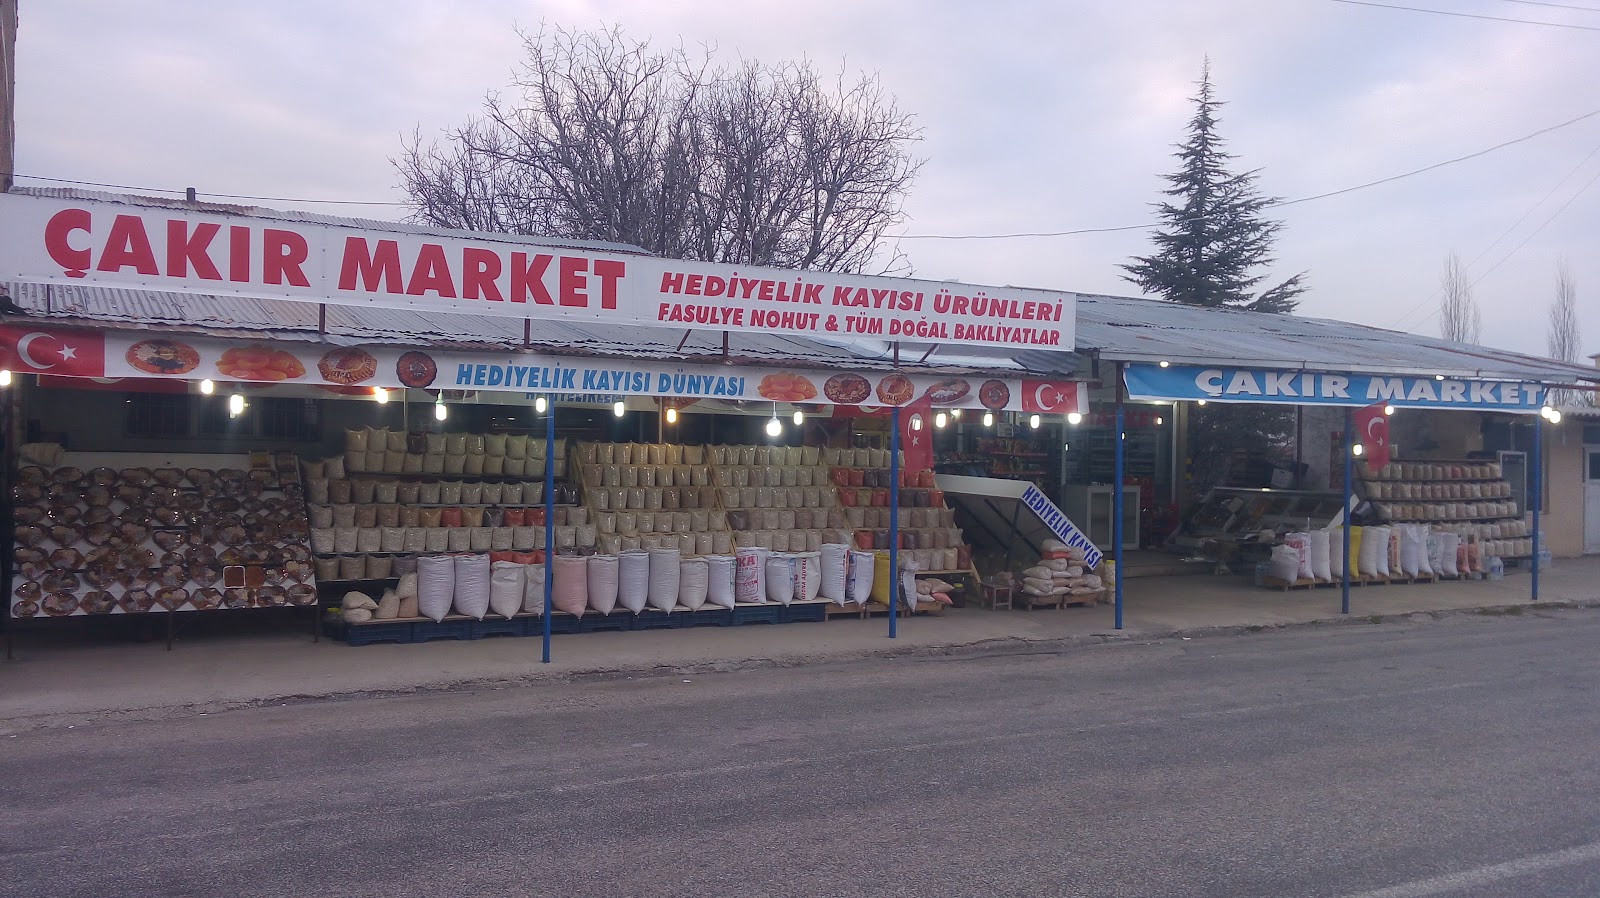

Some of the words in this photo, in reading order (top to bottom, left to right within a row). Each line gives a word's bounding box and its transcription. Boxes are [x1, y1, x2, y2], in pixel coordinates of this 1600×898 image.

[45, 208, 311, 287] ÇAKIR
[338, 236, 626, 310] MARKET
[660, 271, 825, 305] HEDİYELİK
[832, 286, 924, 312] KAYISI
[933, 289, 1063, 322] ÜRÜNLERİ
[658, 303, 744, 326] FASULYE
[750, 309, 820, 331] NOHUT
[825, 314, 838, 332] &
[846, 312, 883, 334] TÜM
[889, 315, 948, 338] DOĞAL
[954, 321, 1060, 346] BAKLİYATLAR
[456, 360, 577, 389] HEDİYELİK
[582, 369, 650, 392] KAYISI
[658, 368, 745, 396] DÜNYASI
[1195, 369, 1350, 398] ÇAKIR
[1366, 377, 1542, 405] MARKET
